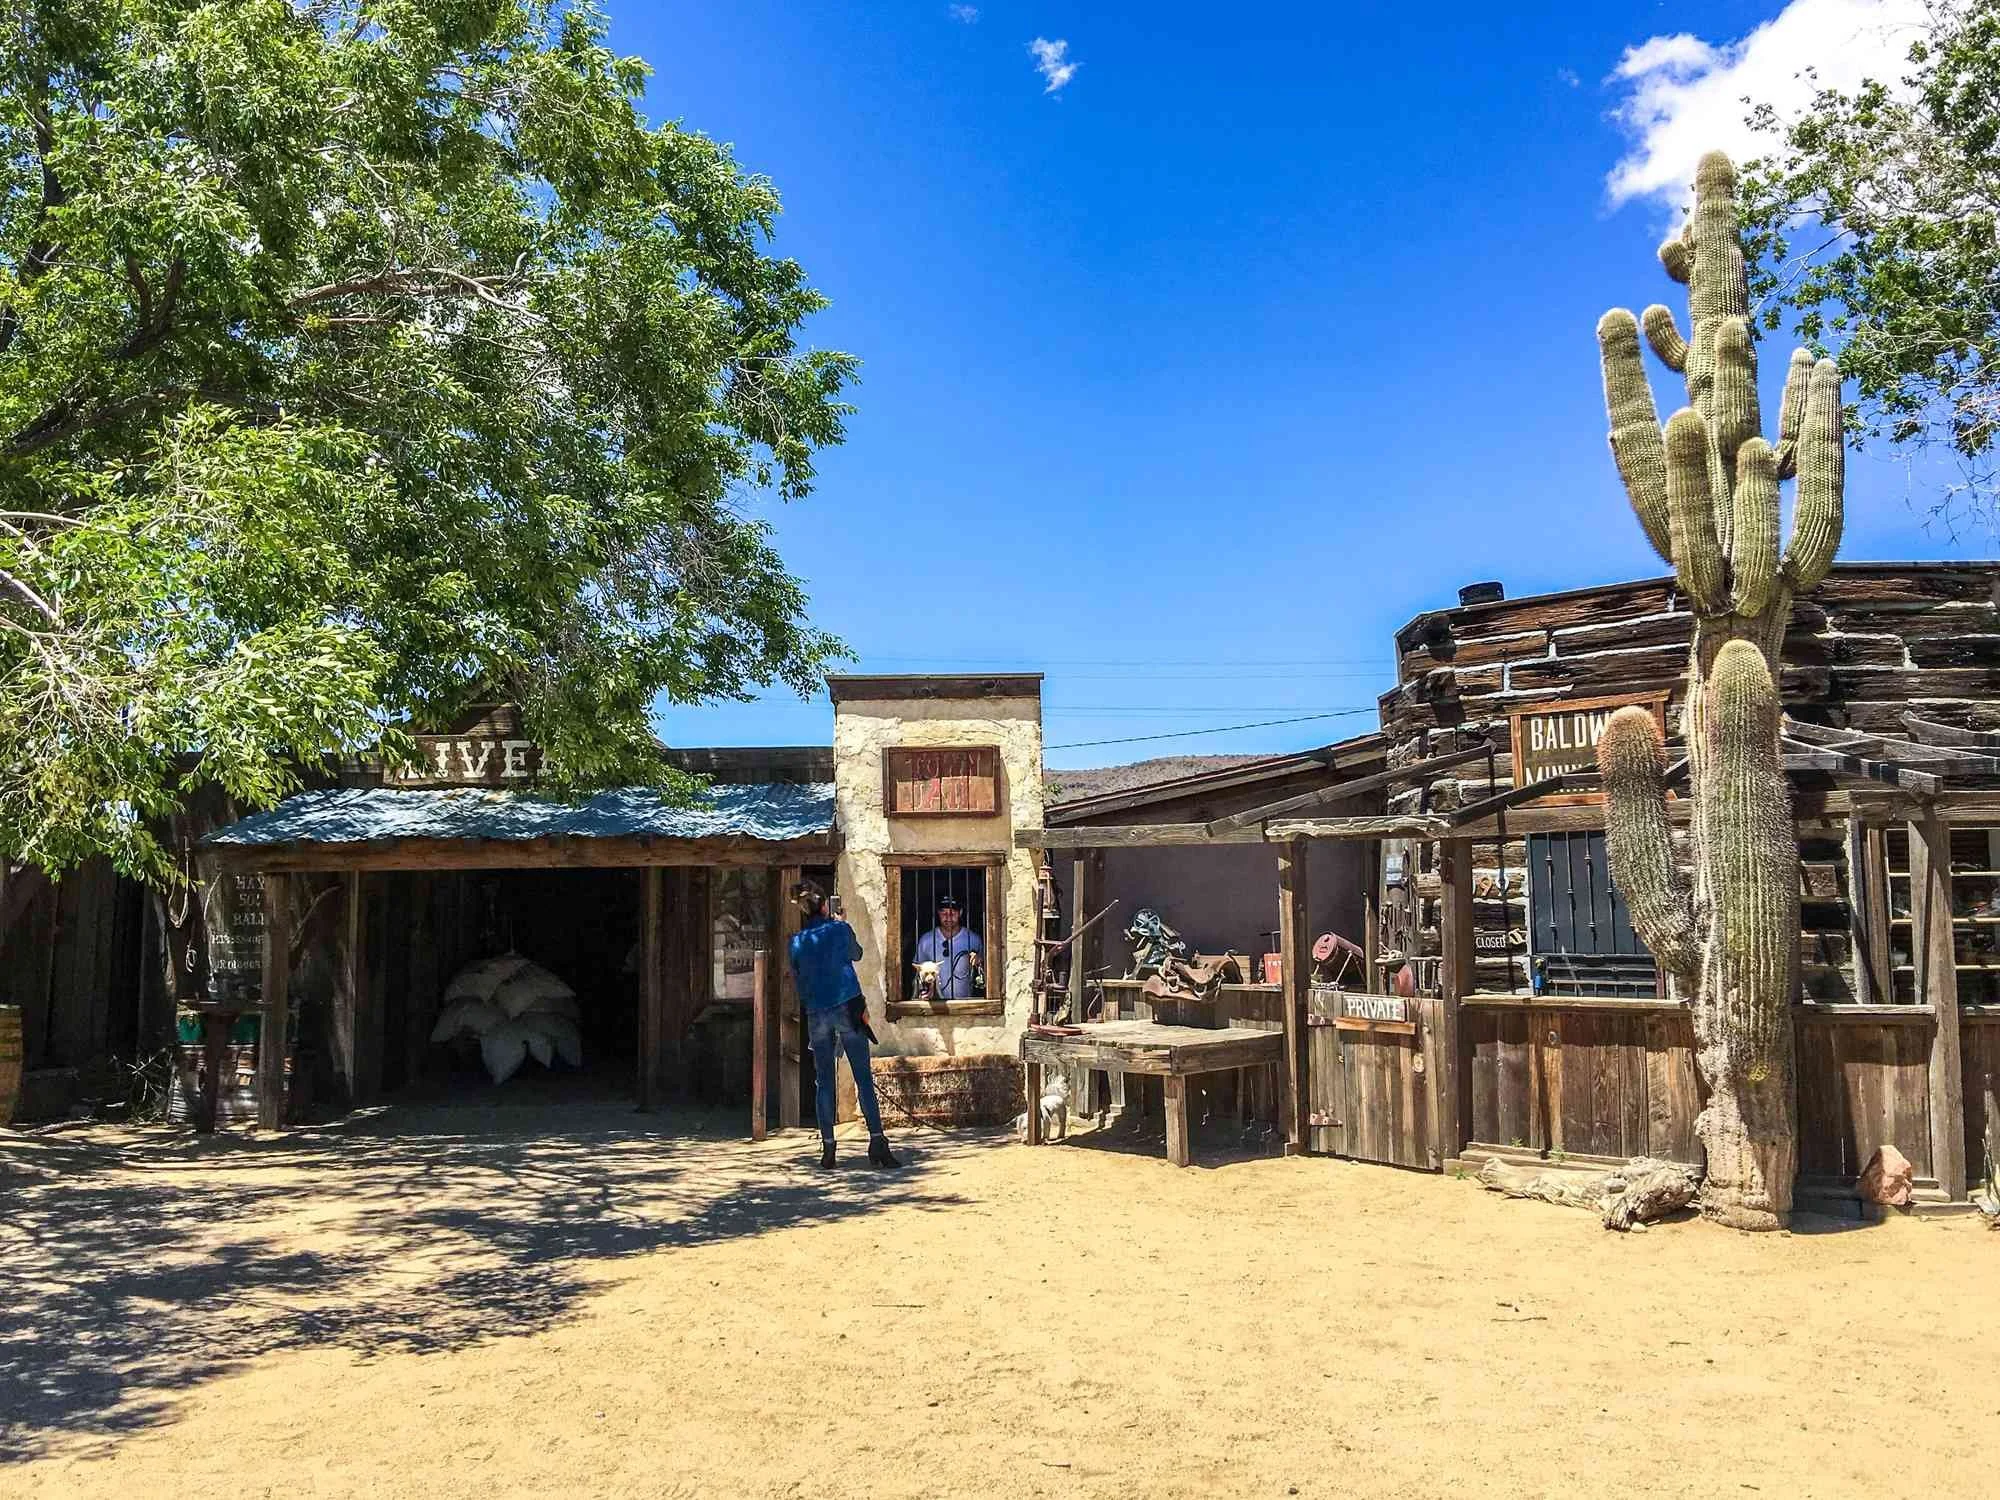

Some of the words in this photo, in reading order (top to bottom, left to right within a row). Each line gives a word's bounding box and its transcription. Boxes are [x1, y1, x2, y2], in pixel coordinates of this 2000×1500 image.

[1530, 711, 1611, 751] BALDW
[1476, 935, 1506, 948] CLOSED
[1345, 998, 1403, 1021] PRIVATE
